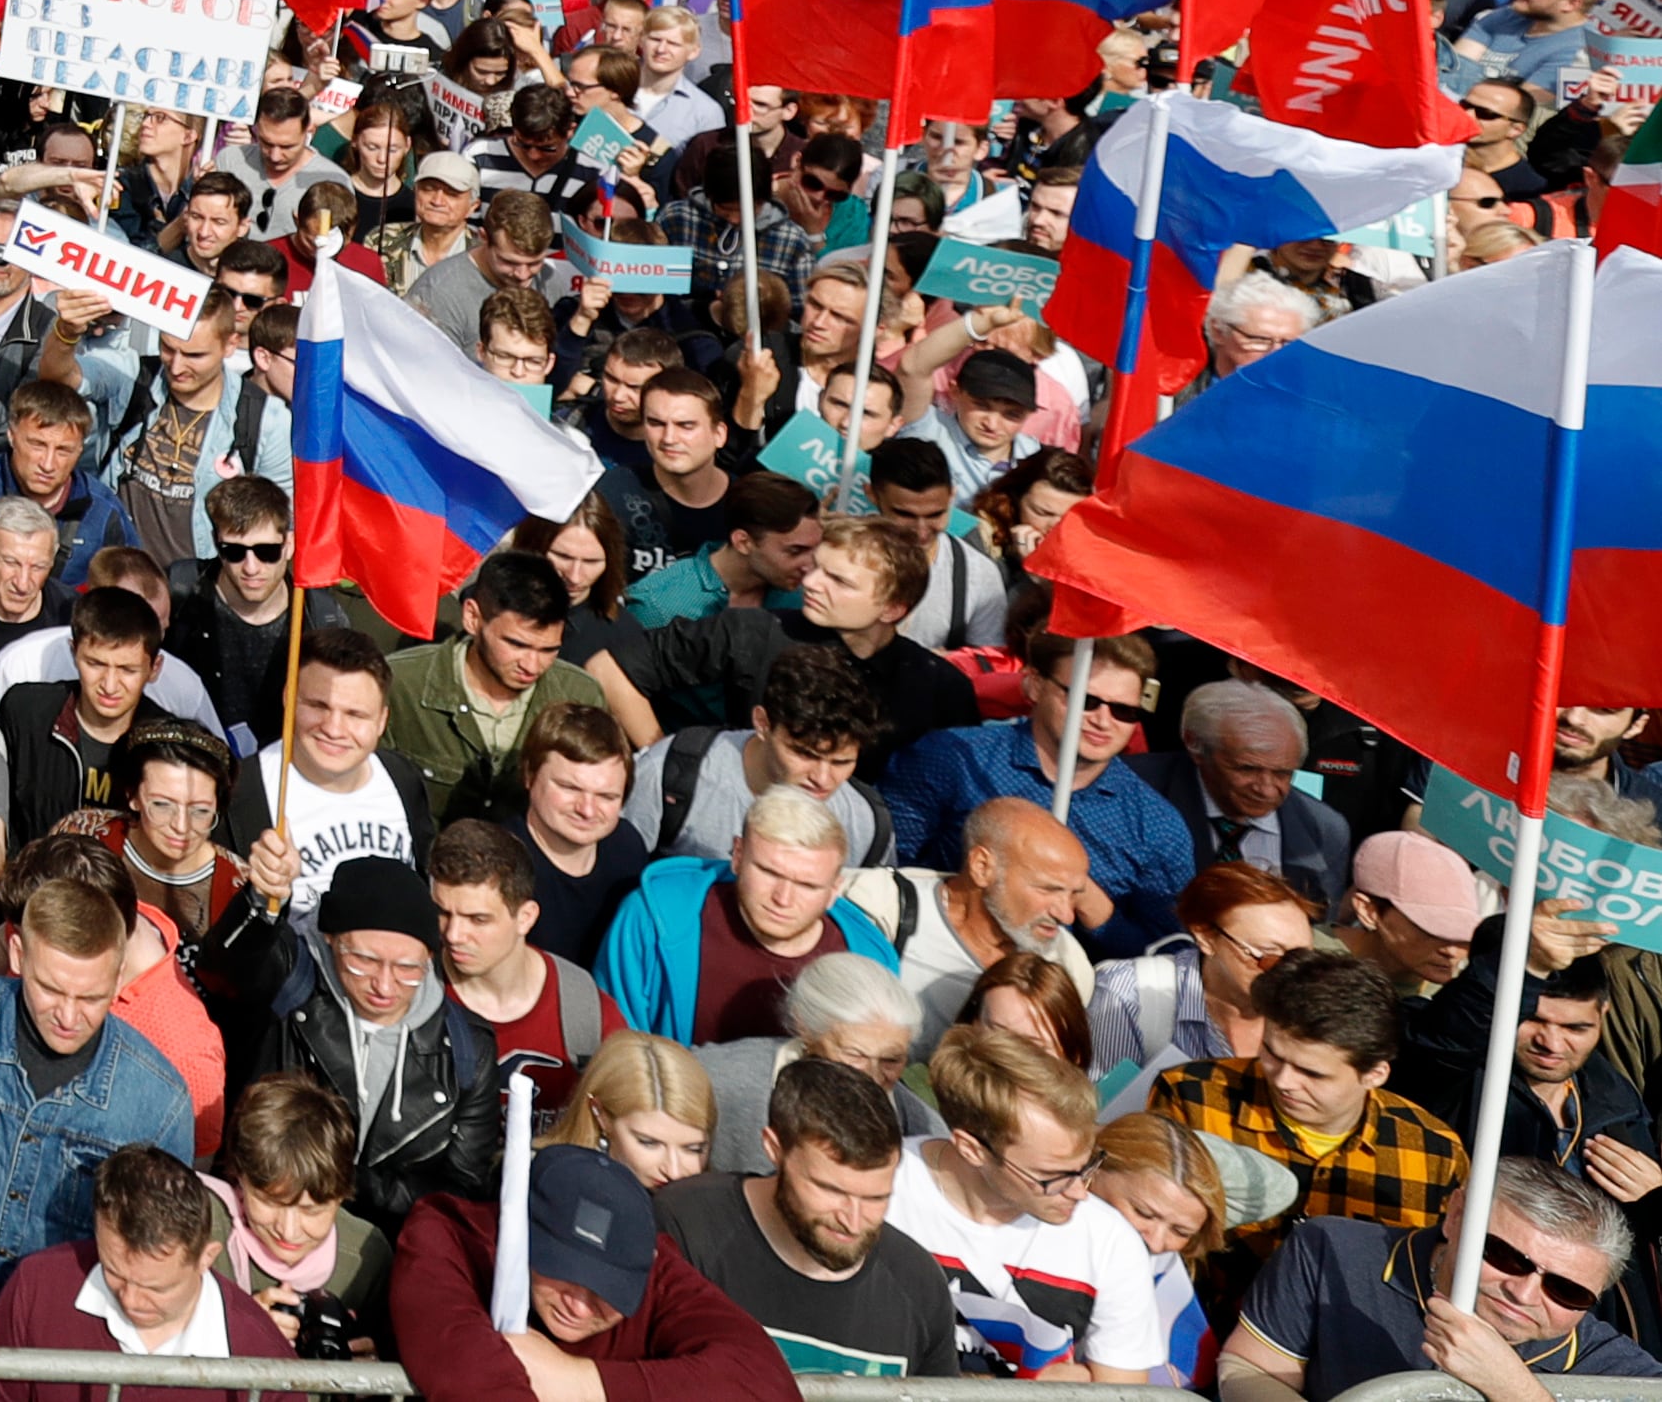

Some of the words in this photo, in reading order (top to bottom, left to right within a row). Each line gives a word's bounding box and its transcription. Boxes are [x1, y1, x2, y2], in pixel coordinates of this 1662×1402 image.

[28, 59, 256, 119] ТЕЛЬСТВА
[56, 241, 197, 320] ЯШИН
[952, 257, 1057, 284] ЛЮБО
[299, 820, 417, 873] RAILHEA
